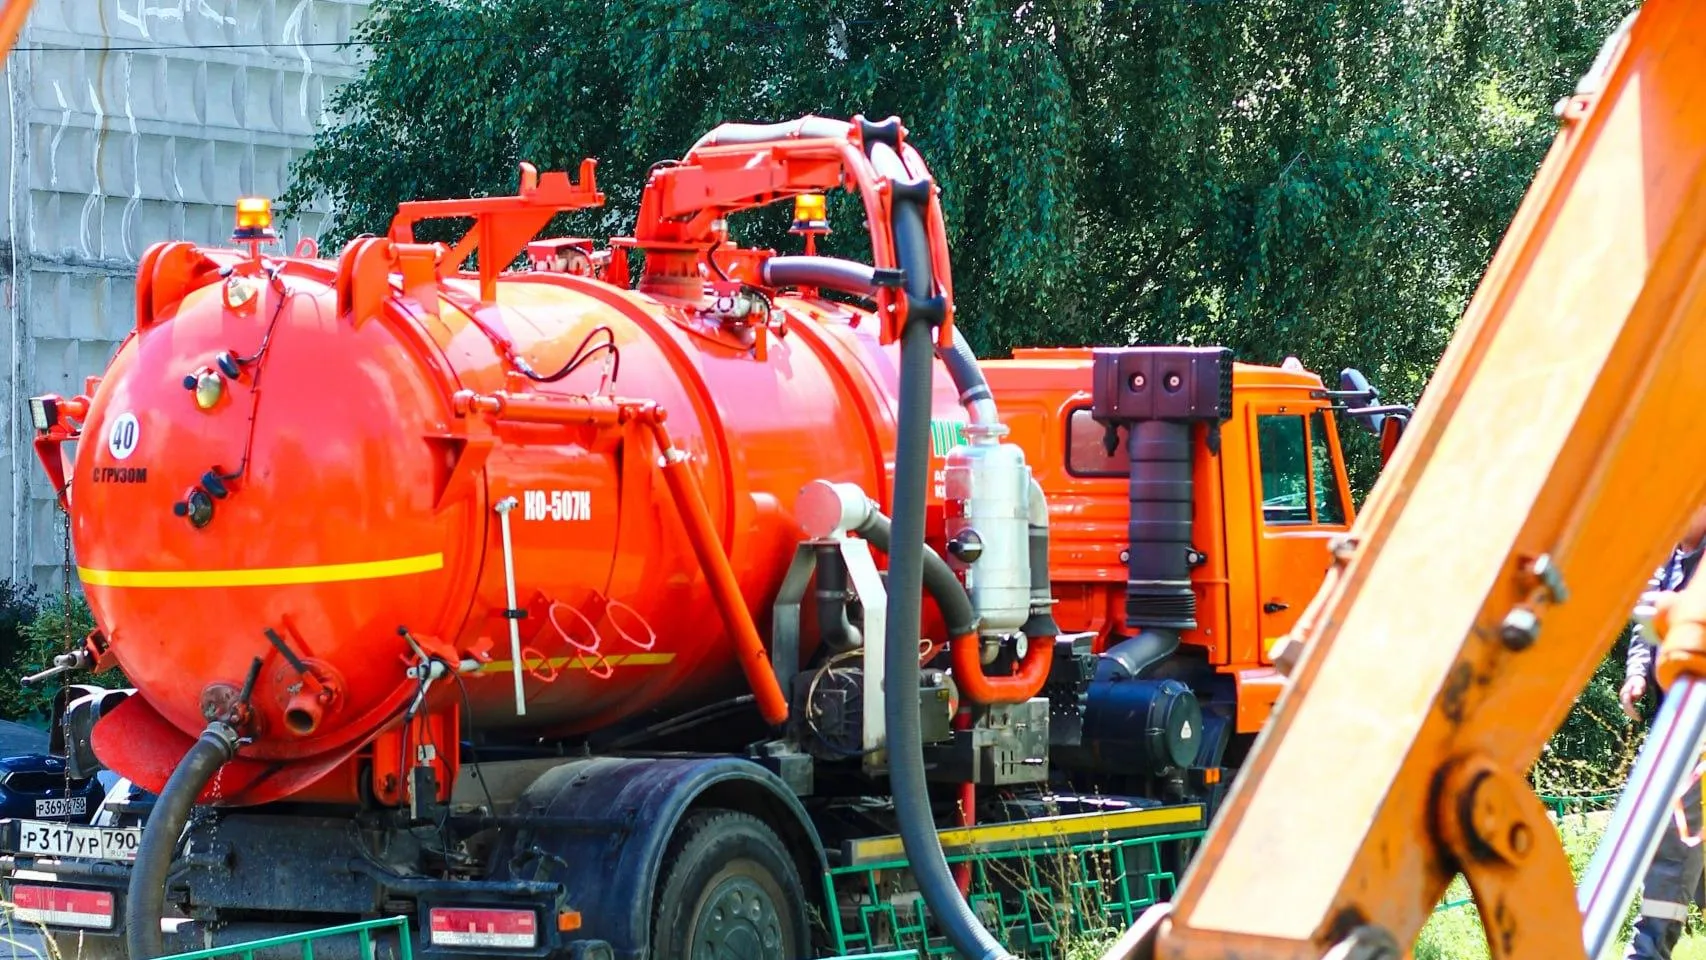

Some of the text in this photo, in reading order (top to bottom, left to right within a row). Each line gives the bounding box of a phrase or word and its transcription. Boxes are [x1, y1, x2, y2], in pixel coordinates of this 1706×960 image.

[113, 420, 134, 450] 40
[93, 467, 147, 483] С ГРУЗОМ
[524, 489, 591, 521] КО-507К
[26, 827, 136, 854] Р317УР 790
